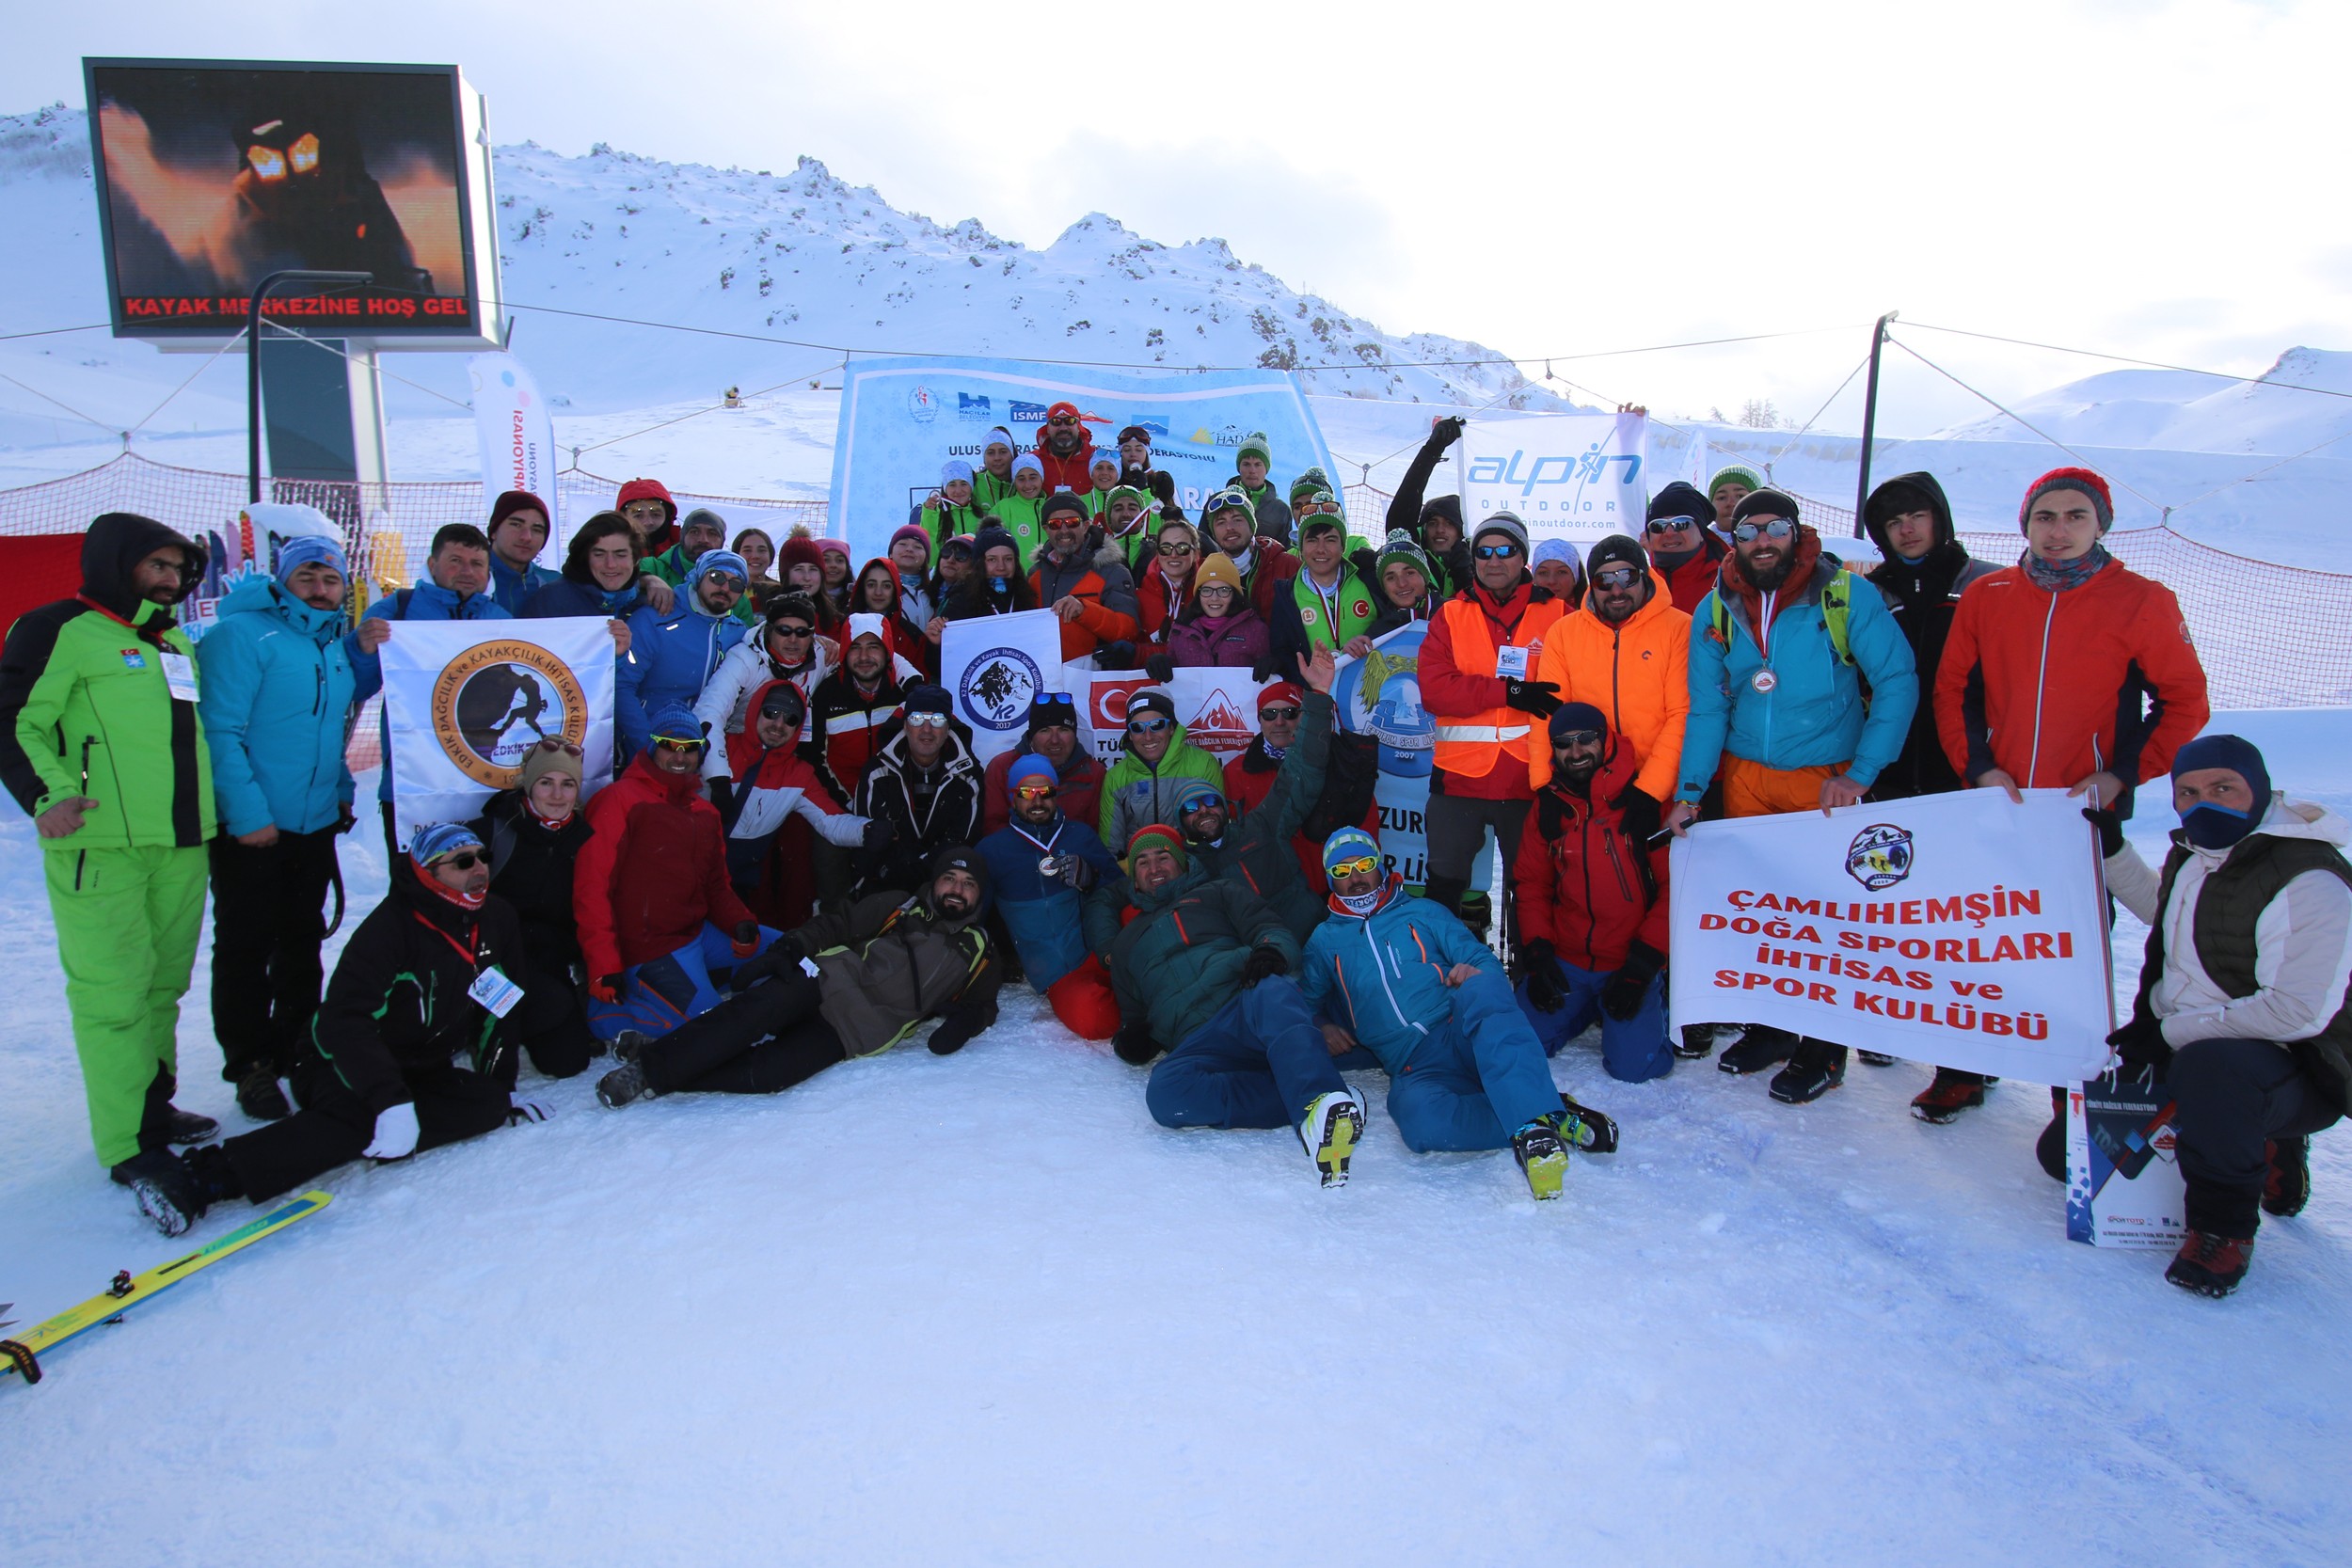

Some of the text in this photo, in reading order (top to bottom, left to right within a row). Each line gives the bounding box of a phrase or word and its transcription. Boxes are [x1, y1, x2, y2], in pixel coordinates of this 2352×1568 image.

[126, 298, 211, 315] KAYAK
[368, 298, 416, 318] HOŞ
[423, 298, 468, 315] GEL
[1013, 411, 1046, 421] ISMF
[1467, 449, 1643, 497] alpin
[1481, 499, 1616, 513] OUTDOOR
[469, 646, 545, 665] KAYAKÇILIK
[981, 650, 1000, 661] Kayak
[1001, 648, 1022, 659] İhtisas
[1020, 655, 1034, 670] Spor
[456, 663, 469, 675] ve
[545, 659, 578, 704] İHTİSAS
[437, 673, 458, 733] DAĞCILIK
[992, 704, 1016, 720] K2
[445, 735, 473, 768] EDKİK
[492, 741, 526, 757] EDKİK
[1097, 738, 1122, 752] TÜ
[1399, 736, 1420, 748] SPOR
[1422, 734, 1436, 746] LİS
[1394, 751, 1415, 759] 2007
[1378, 806, 1426, 833] ZUR
[1727, 884, 2042, 929] ÇAMLIHEMŞİN
[1699, 913, 2074, 963] DOĞA SPORLARI
[1756, 942, 2003, 1000] İHTİSAS ve
[1712, 969, 2049, 1041] SPOR KULÜBÜ
